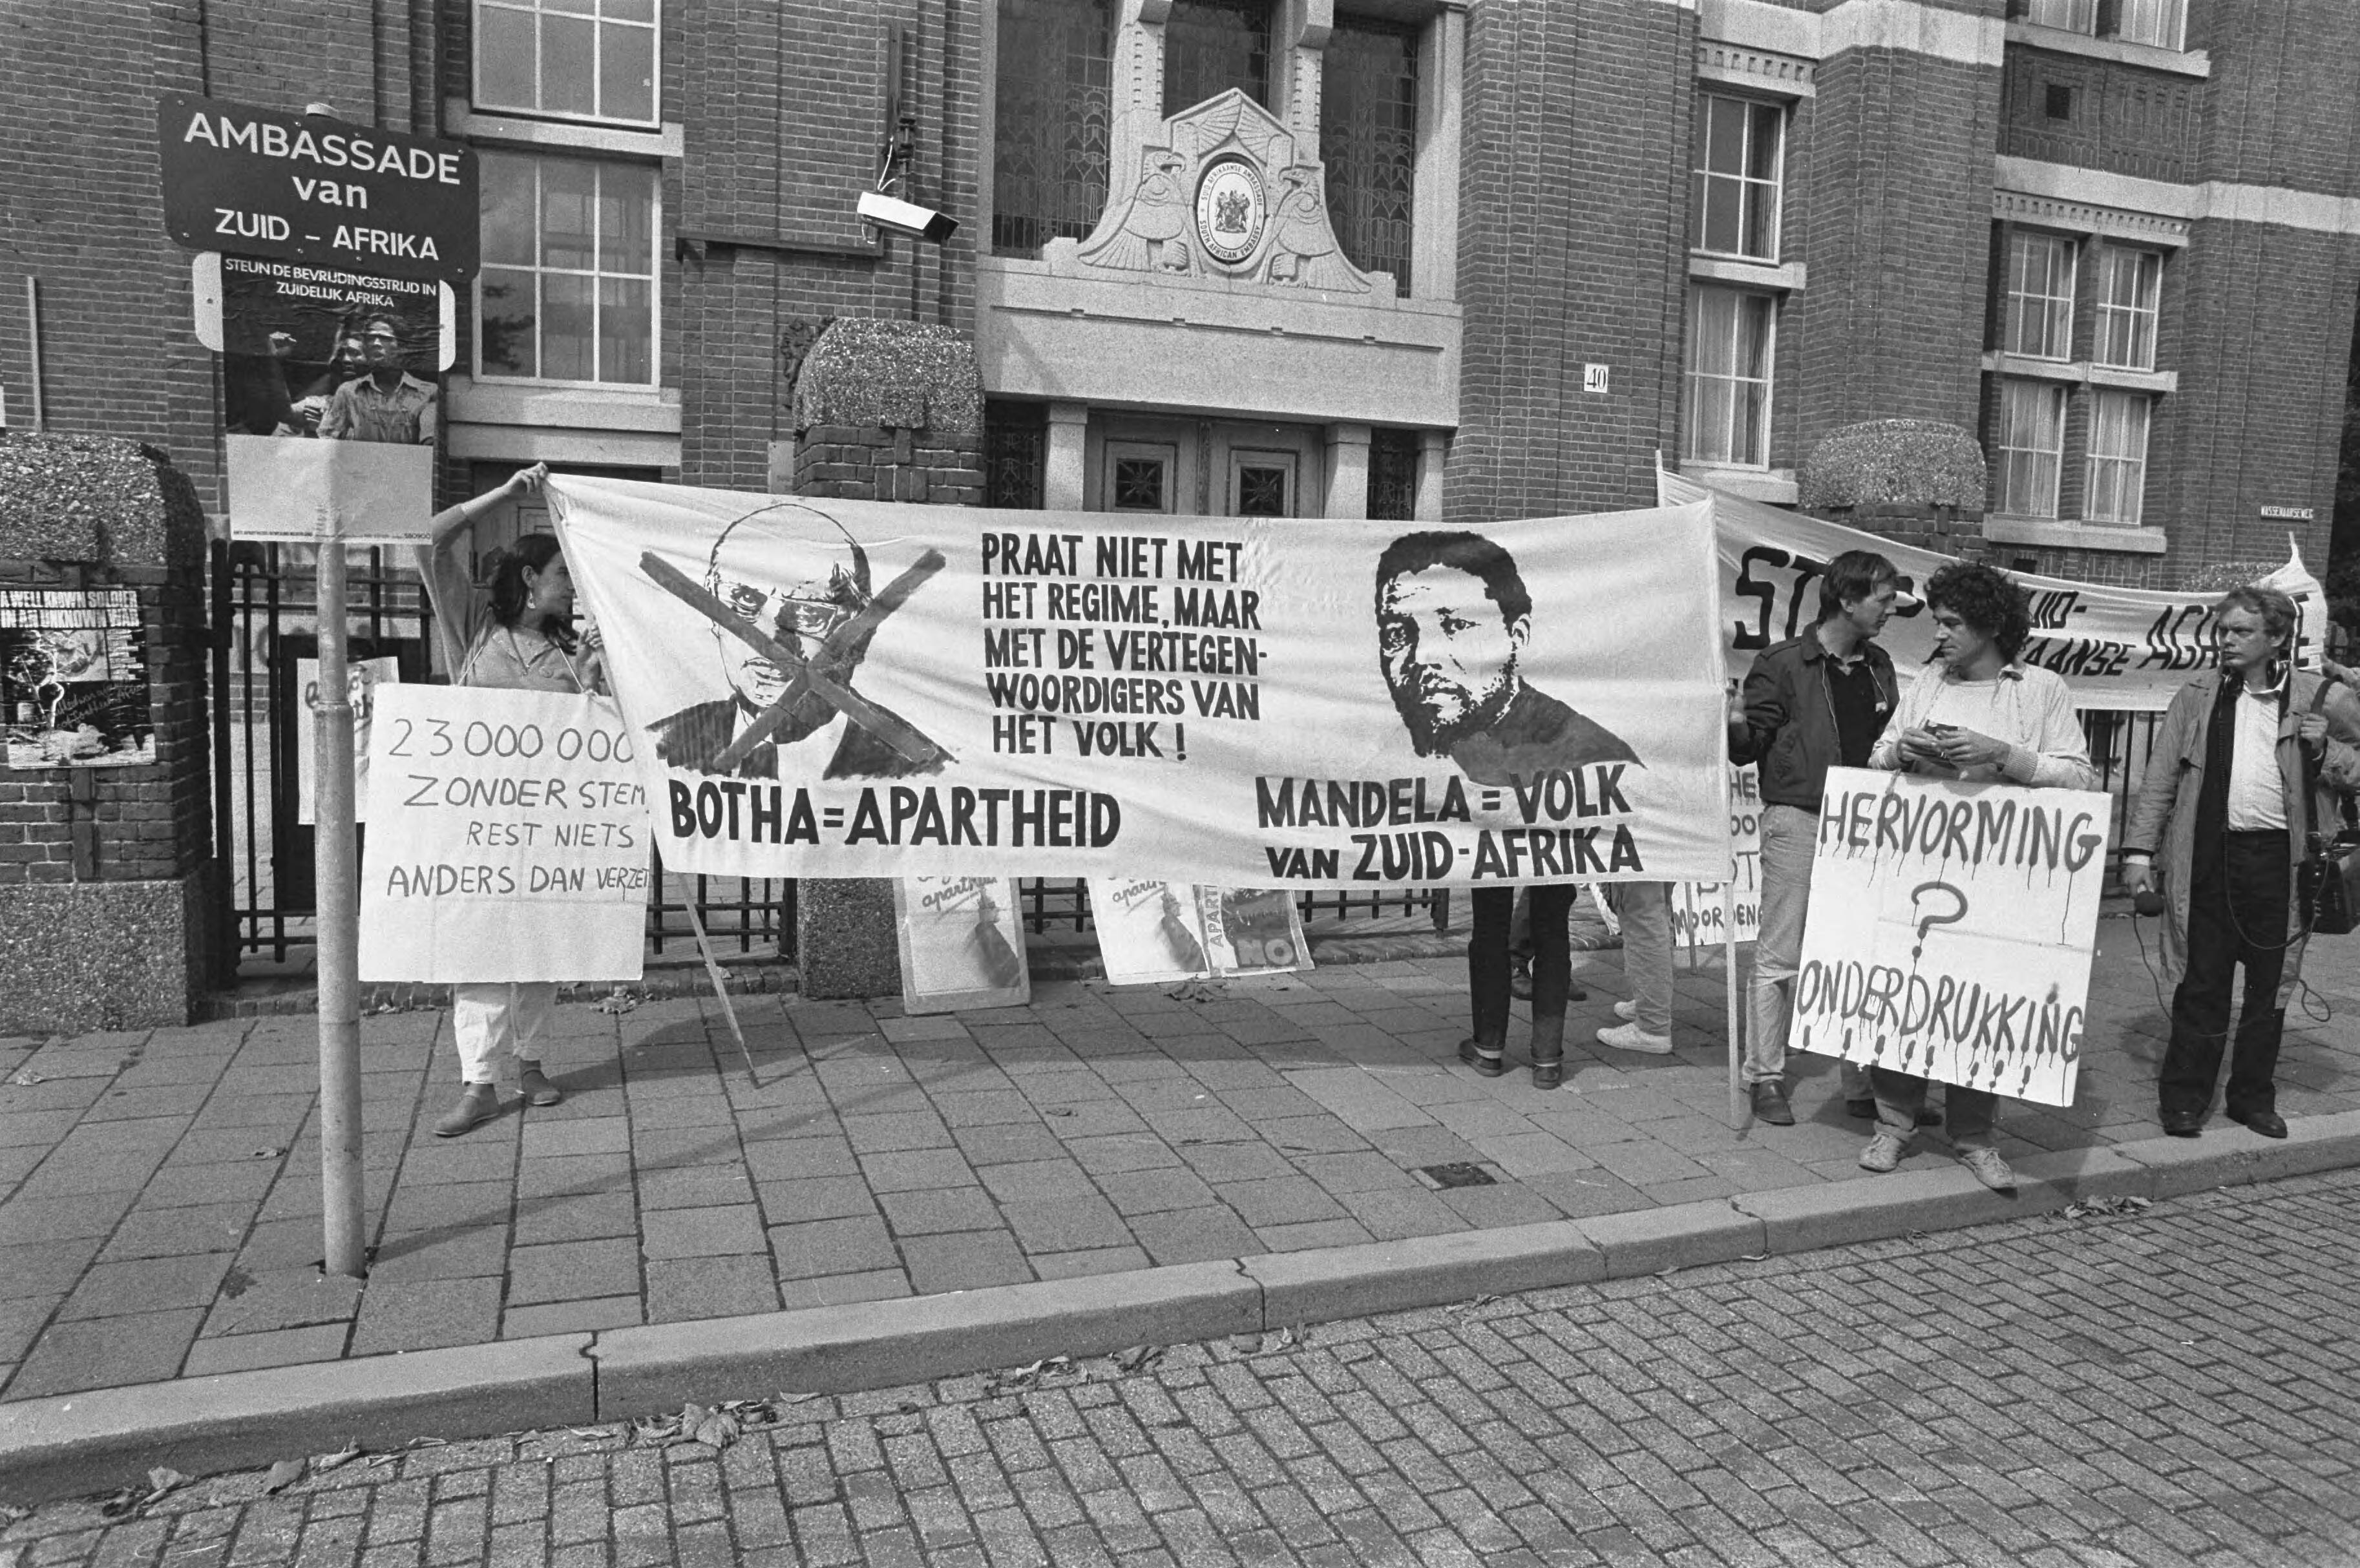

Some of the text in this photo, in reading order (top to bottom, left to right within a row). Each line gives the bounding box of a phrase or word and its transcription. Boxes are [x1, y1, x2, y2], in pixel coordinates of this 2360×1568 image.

[184, 112, 461, 185] AMBASSADE
[291, 176, 368, 209] van
[1243, 169, 1263, 206] AMBASSADE
[215, 207, 290, 241] ZUID
[332, 225, 439, 261] AFRIKA
[1199, 220, 1261, 259] SOUTH AFRICAN EMBASSY
[226, 258, 437, 297] STEUN DE BEVRIJDINGSSTRIJD IN
[276, 281, 395, 308] ZUIDELIJK AFRIKA
[1586, 368, 1607, 390] 40
[982, 532, 1243, 583] PRAAT NIET MET
[87, 590, 138, 609] SOLDIER
[982, 581, 1262, 631] HET REGIME, MAAR
[984, 627, 1268, 676] MET DE VERTEGEN-
[985, 672, 1260, 721] WOORDIGERS VAN
[993, 714, 1057, 755] HET
[1072, 720, 1165, 758] VOLK
[403, 774, 646, 809] ZONDER STEM
[1255, 774, 1472, 828] MANDELA
[1509, 763, 1633, 824] VOLK
[466, 821, 634, 848] REST NIETS
[1820, 790, 2102, 873] HERVORMING
[386, 864, 516, 897] ANDERS
[530, 864, 585, 894] DAN
[1265, 846, 1340, 879] VAN
[1912, 881, 1968, 959] ?
[1797, 959, 2083, 1063] ONDERDRUKKING
